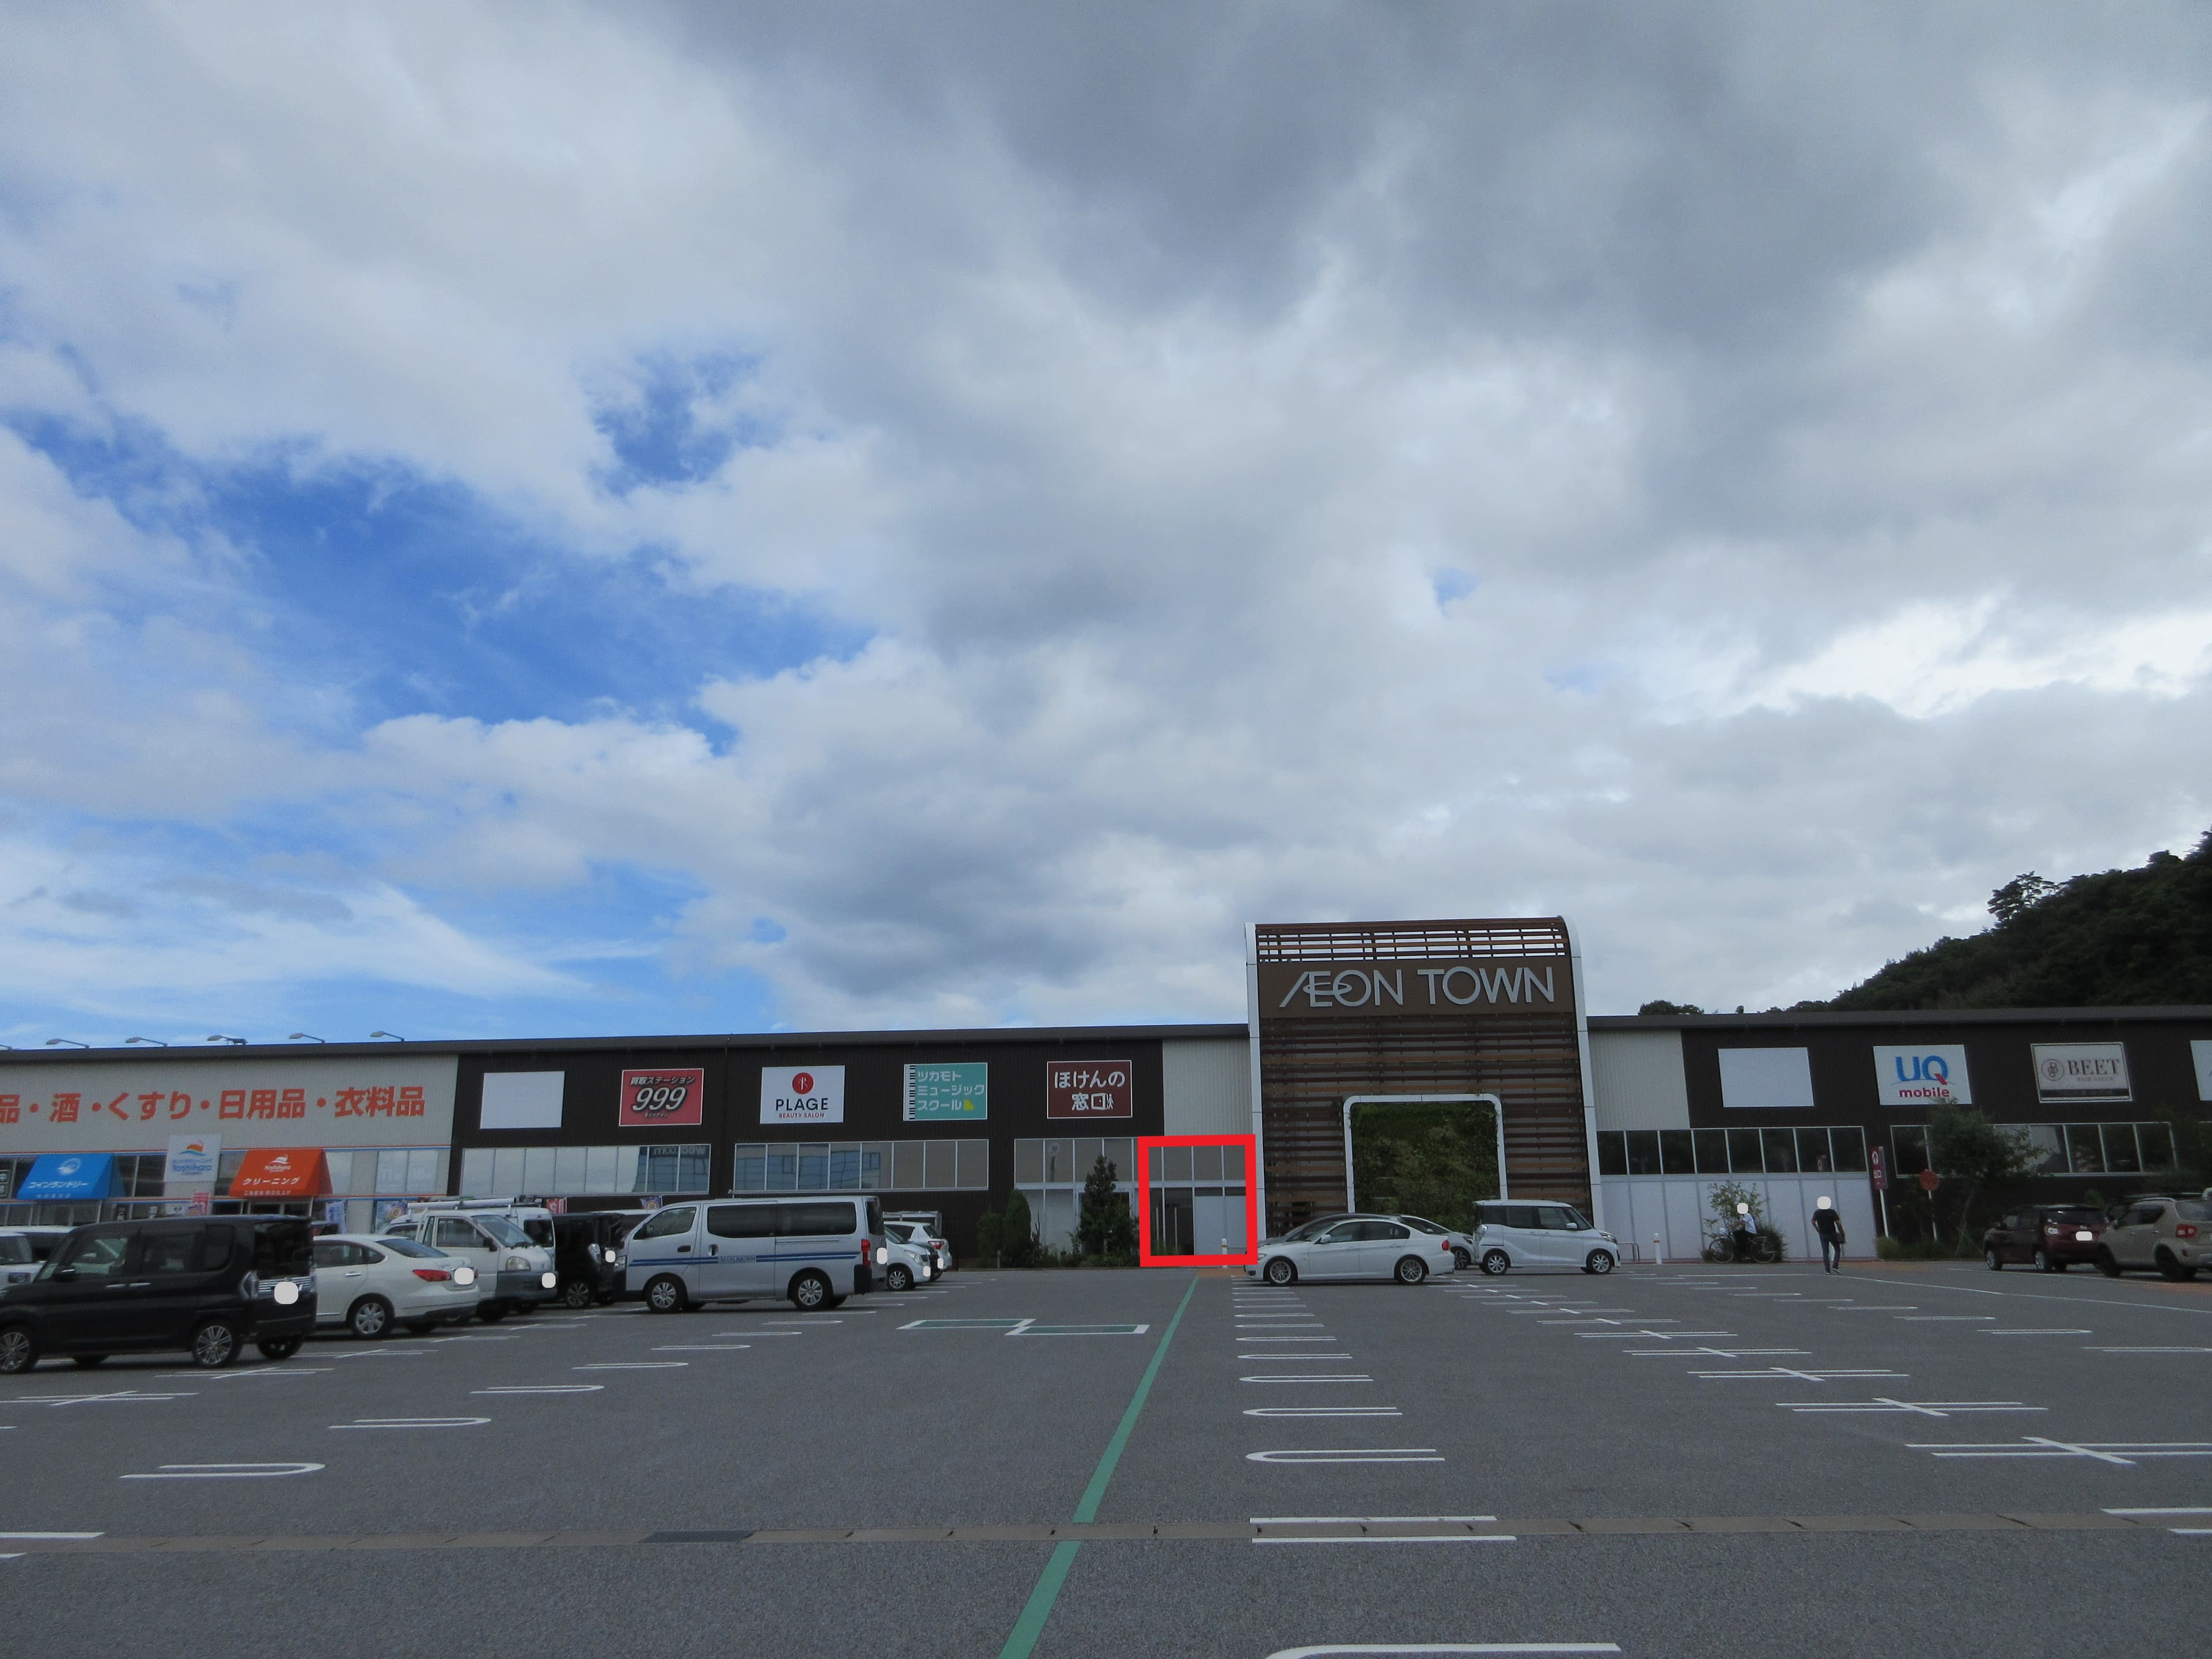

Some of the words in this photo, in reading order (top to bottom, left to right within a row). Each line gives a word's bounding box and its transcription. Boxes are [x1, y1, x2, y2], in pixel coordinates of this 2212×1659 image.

[1417, 966, 1554, 1005] TOWN
[1895, 1055, 1949, 1085] UQ
[2067, 1059, 2120, 1075] BEET
[917, 1070, 962, 1082] ツカモト
[1054, 1070, 1126, 1089] ほけんの
[917, 1084, 985, 1096] ミュージック
[1899, 1087, 1950, 1098] mobile
[632, 1086, 686, 1111] 999
[775, 1097, 828, 1111] PLAGE
[917, 1099, 962, 1111] スクール
[1071, 1092, 1108, 1111] 窓口
[243, 1176, 301, 1185] クリーニング
